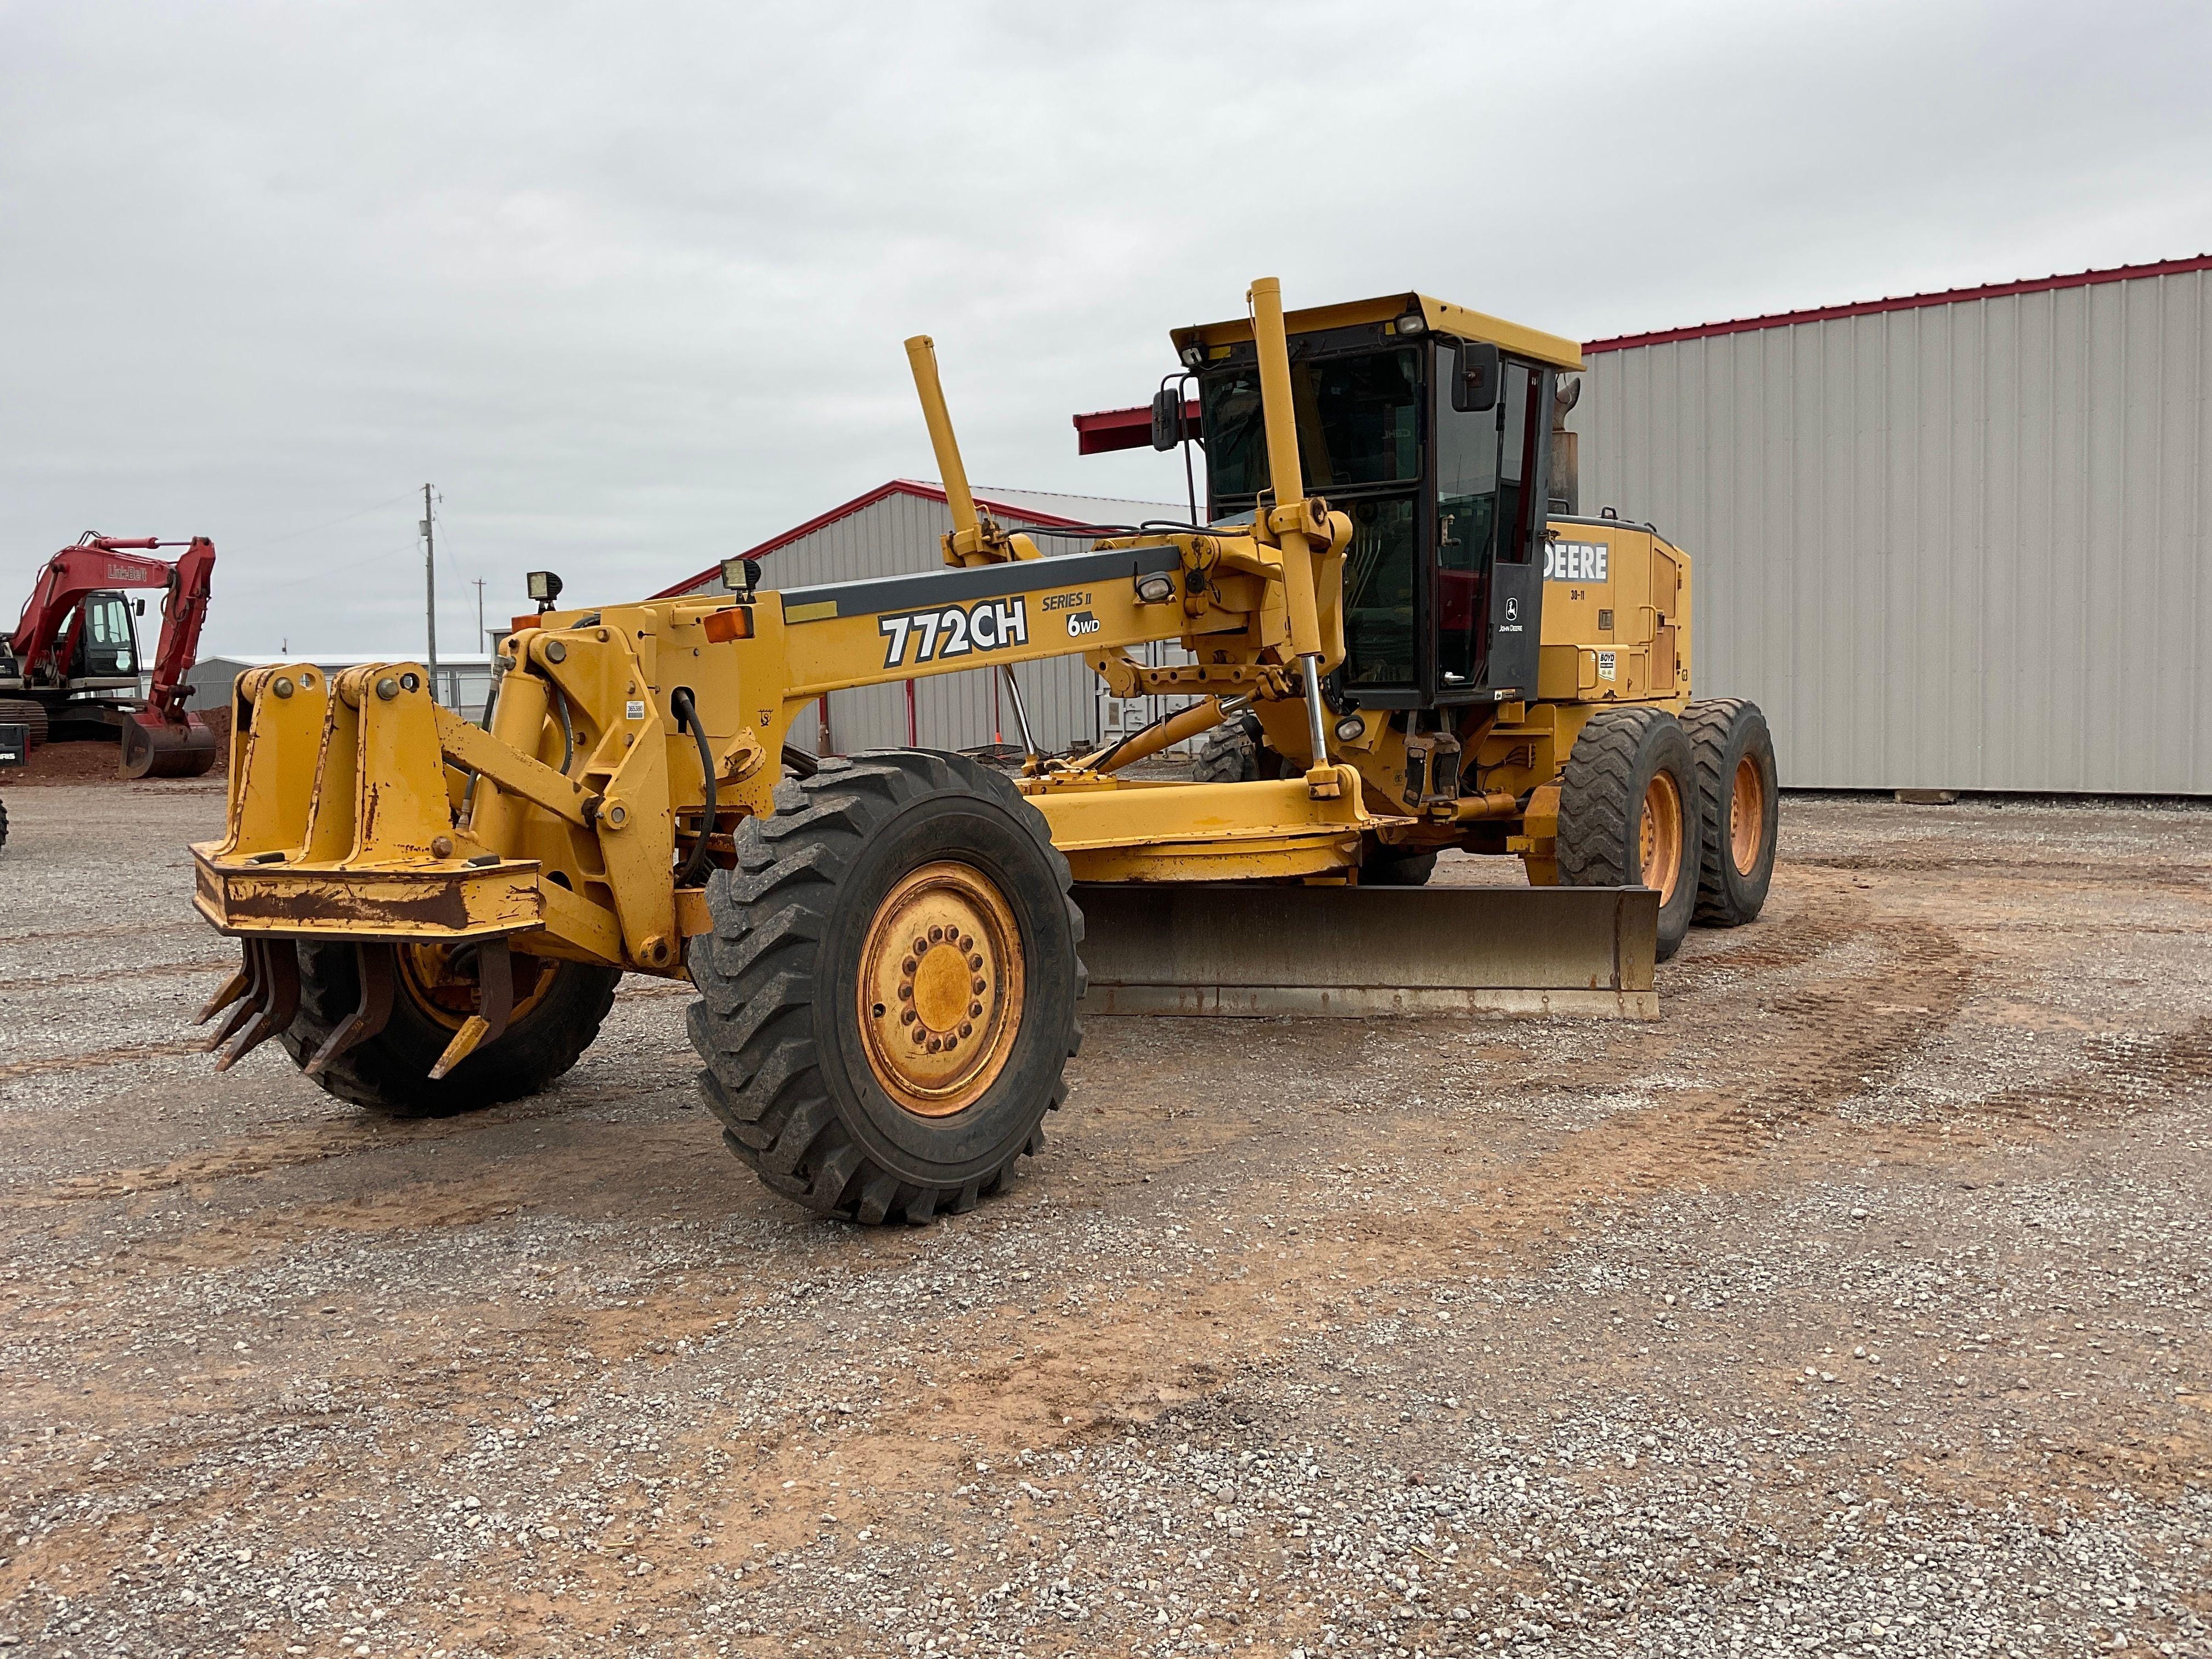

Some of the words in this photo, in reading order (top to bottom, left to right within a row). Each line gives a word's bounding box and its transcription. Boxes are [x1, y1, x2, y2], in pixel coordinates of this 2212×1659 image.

[1543, 544, 1607, 579] DEERE
[108, 564, 147, 582] Link-Belt
[1042, 592, 1083, 612] SERIES
[1571, 590, 1585, 600] 30-11
[880, 599, 1027, 665] 772CH
[1067, 614, 1101, 637] 6WD
